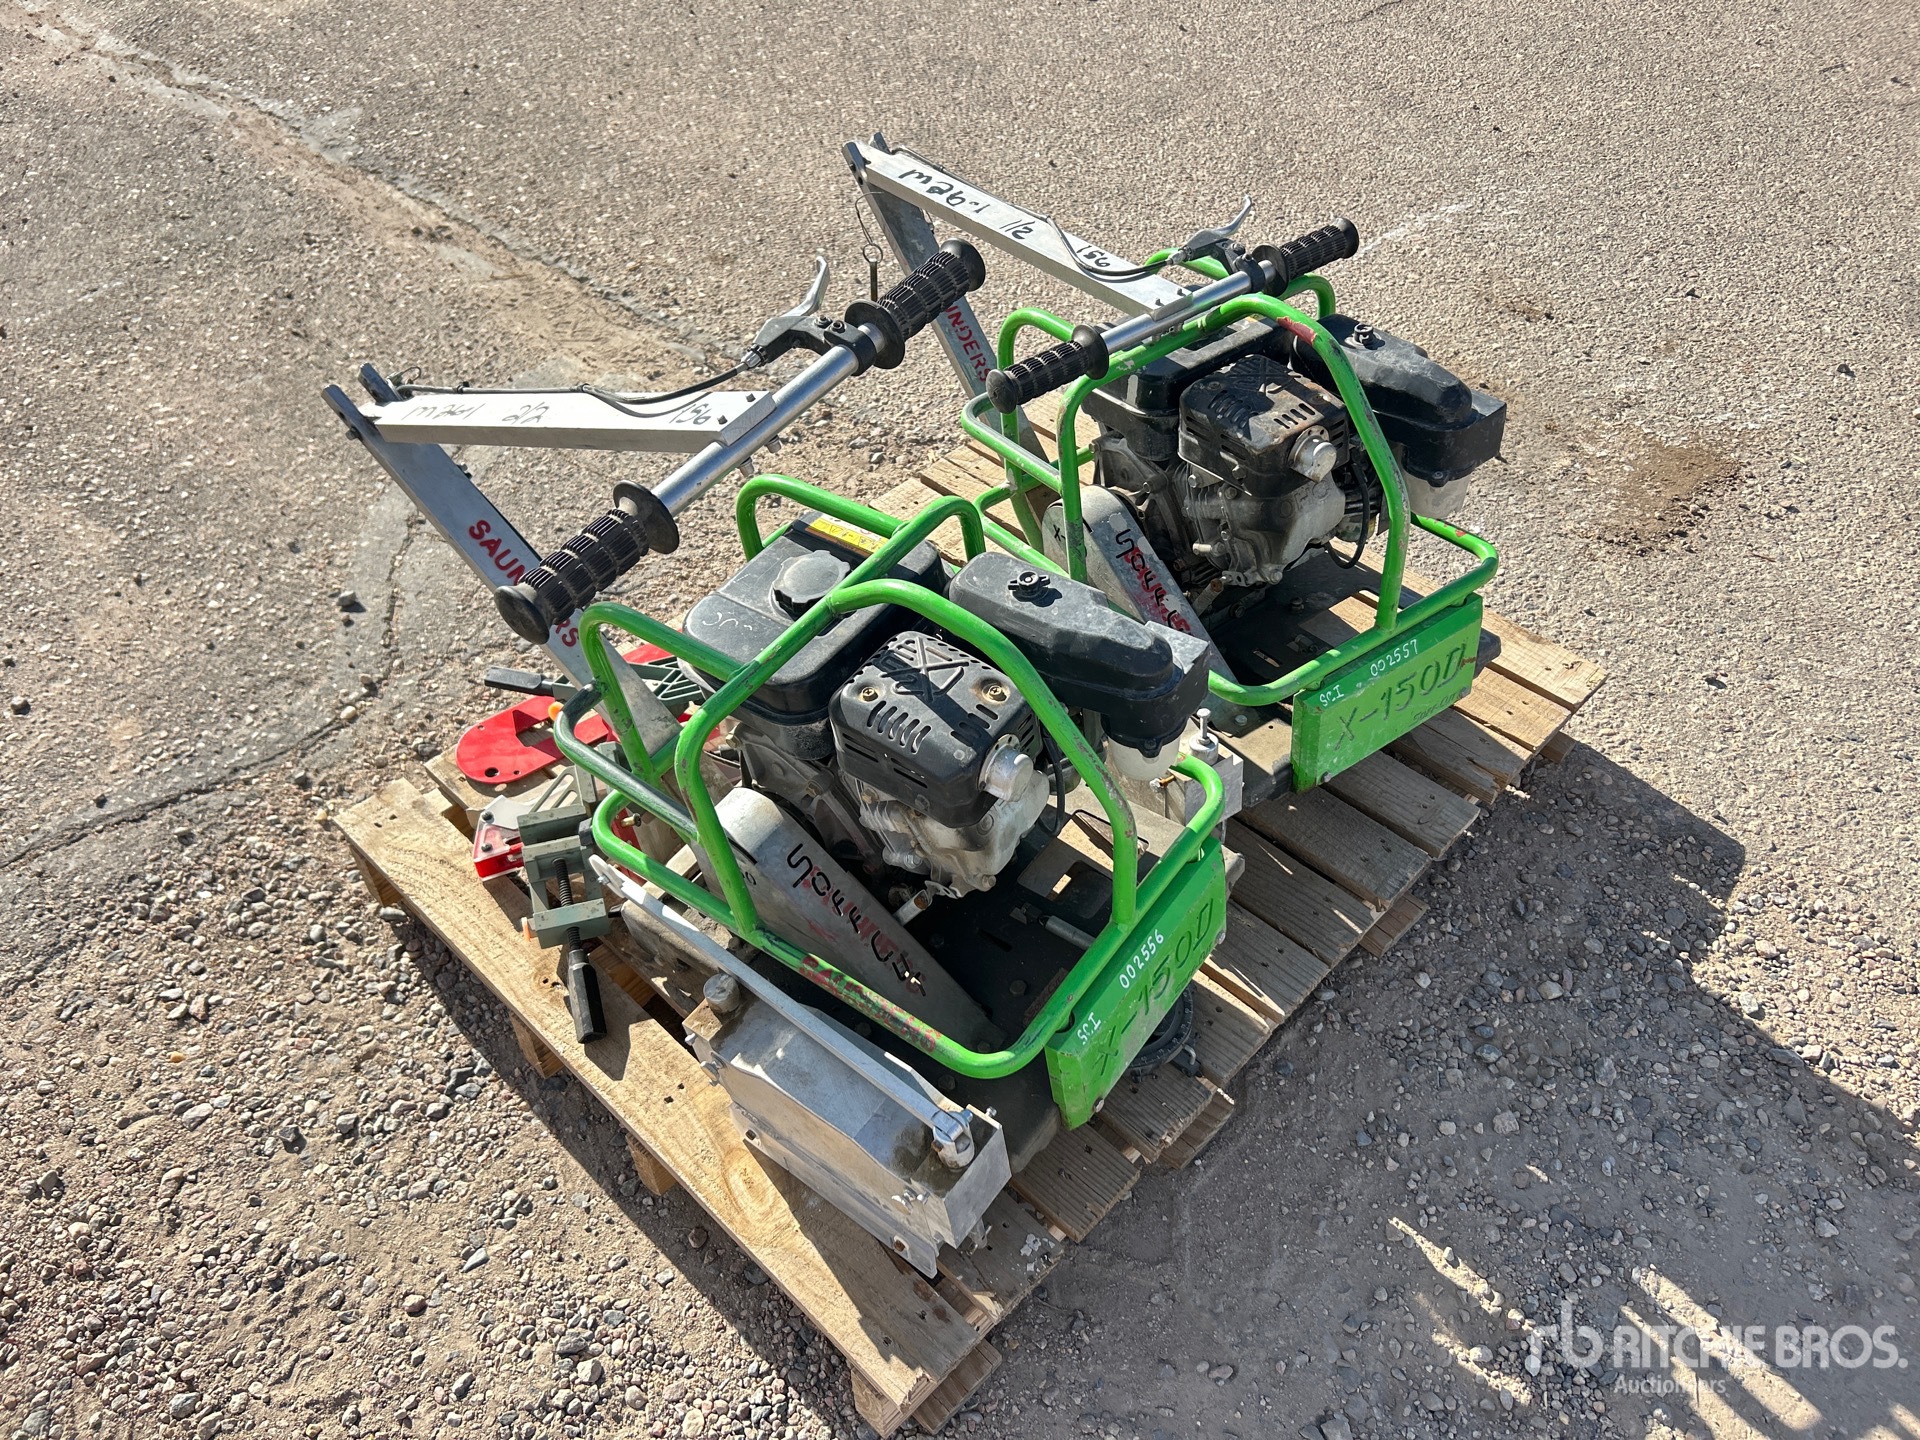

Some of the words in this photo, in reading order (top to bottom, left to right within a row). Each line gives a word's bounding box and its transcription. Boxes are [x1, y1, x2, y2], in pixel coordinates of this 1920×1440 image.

[999, 219, 1036, 240] 1/2
[1076, 244, 1112, 268] 156
[500, 402, 550, 425] 2/2
[668, 403, 713, 425] 156
[1319, 685, 1344, 707] SCI
[1369, 639, 1419, 677] 002557
[1334, 642, 1467, 751] X-150D
[1077, 1012, 1102, 1046] SCI
[1119, 929, 1165, 990] 002556
[1091, 897, 1214, 1077] X-150D
